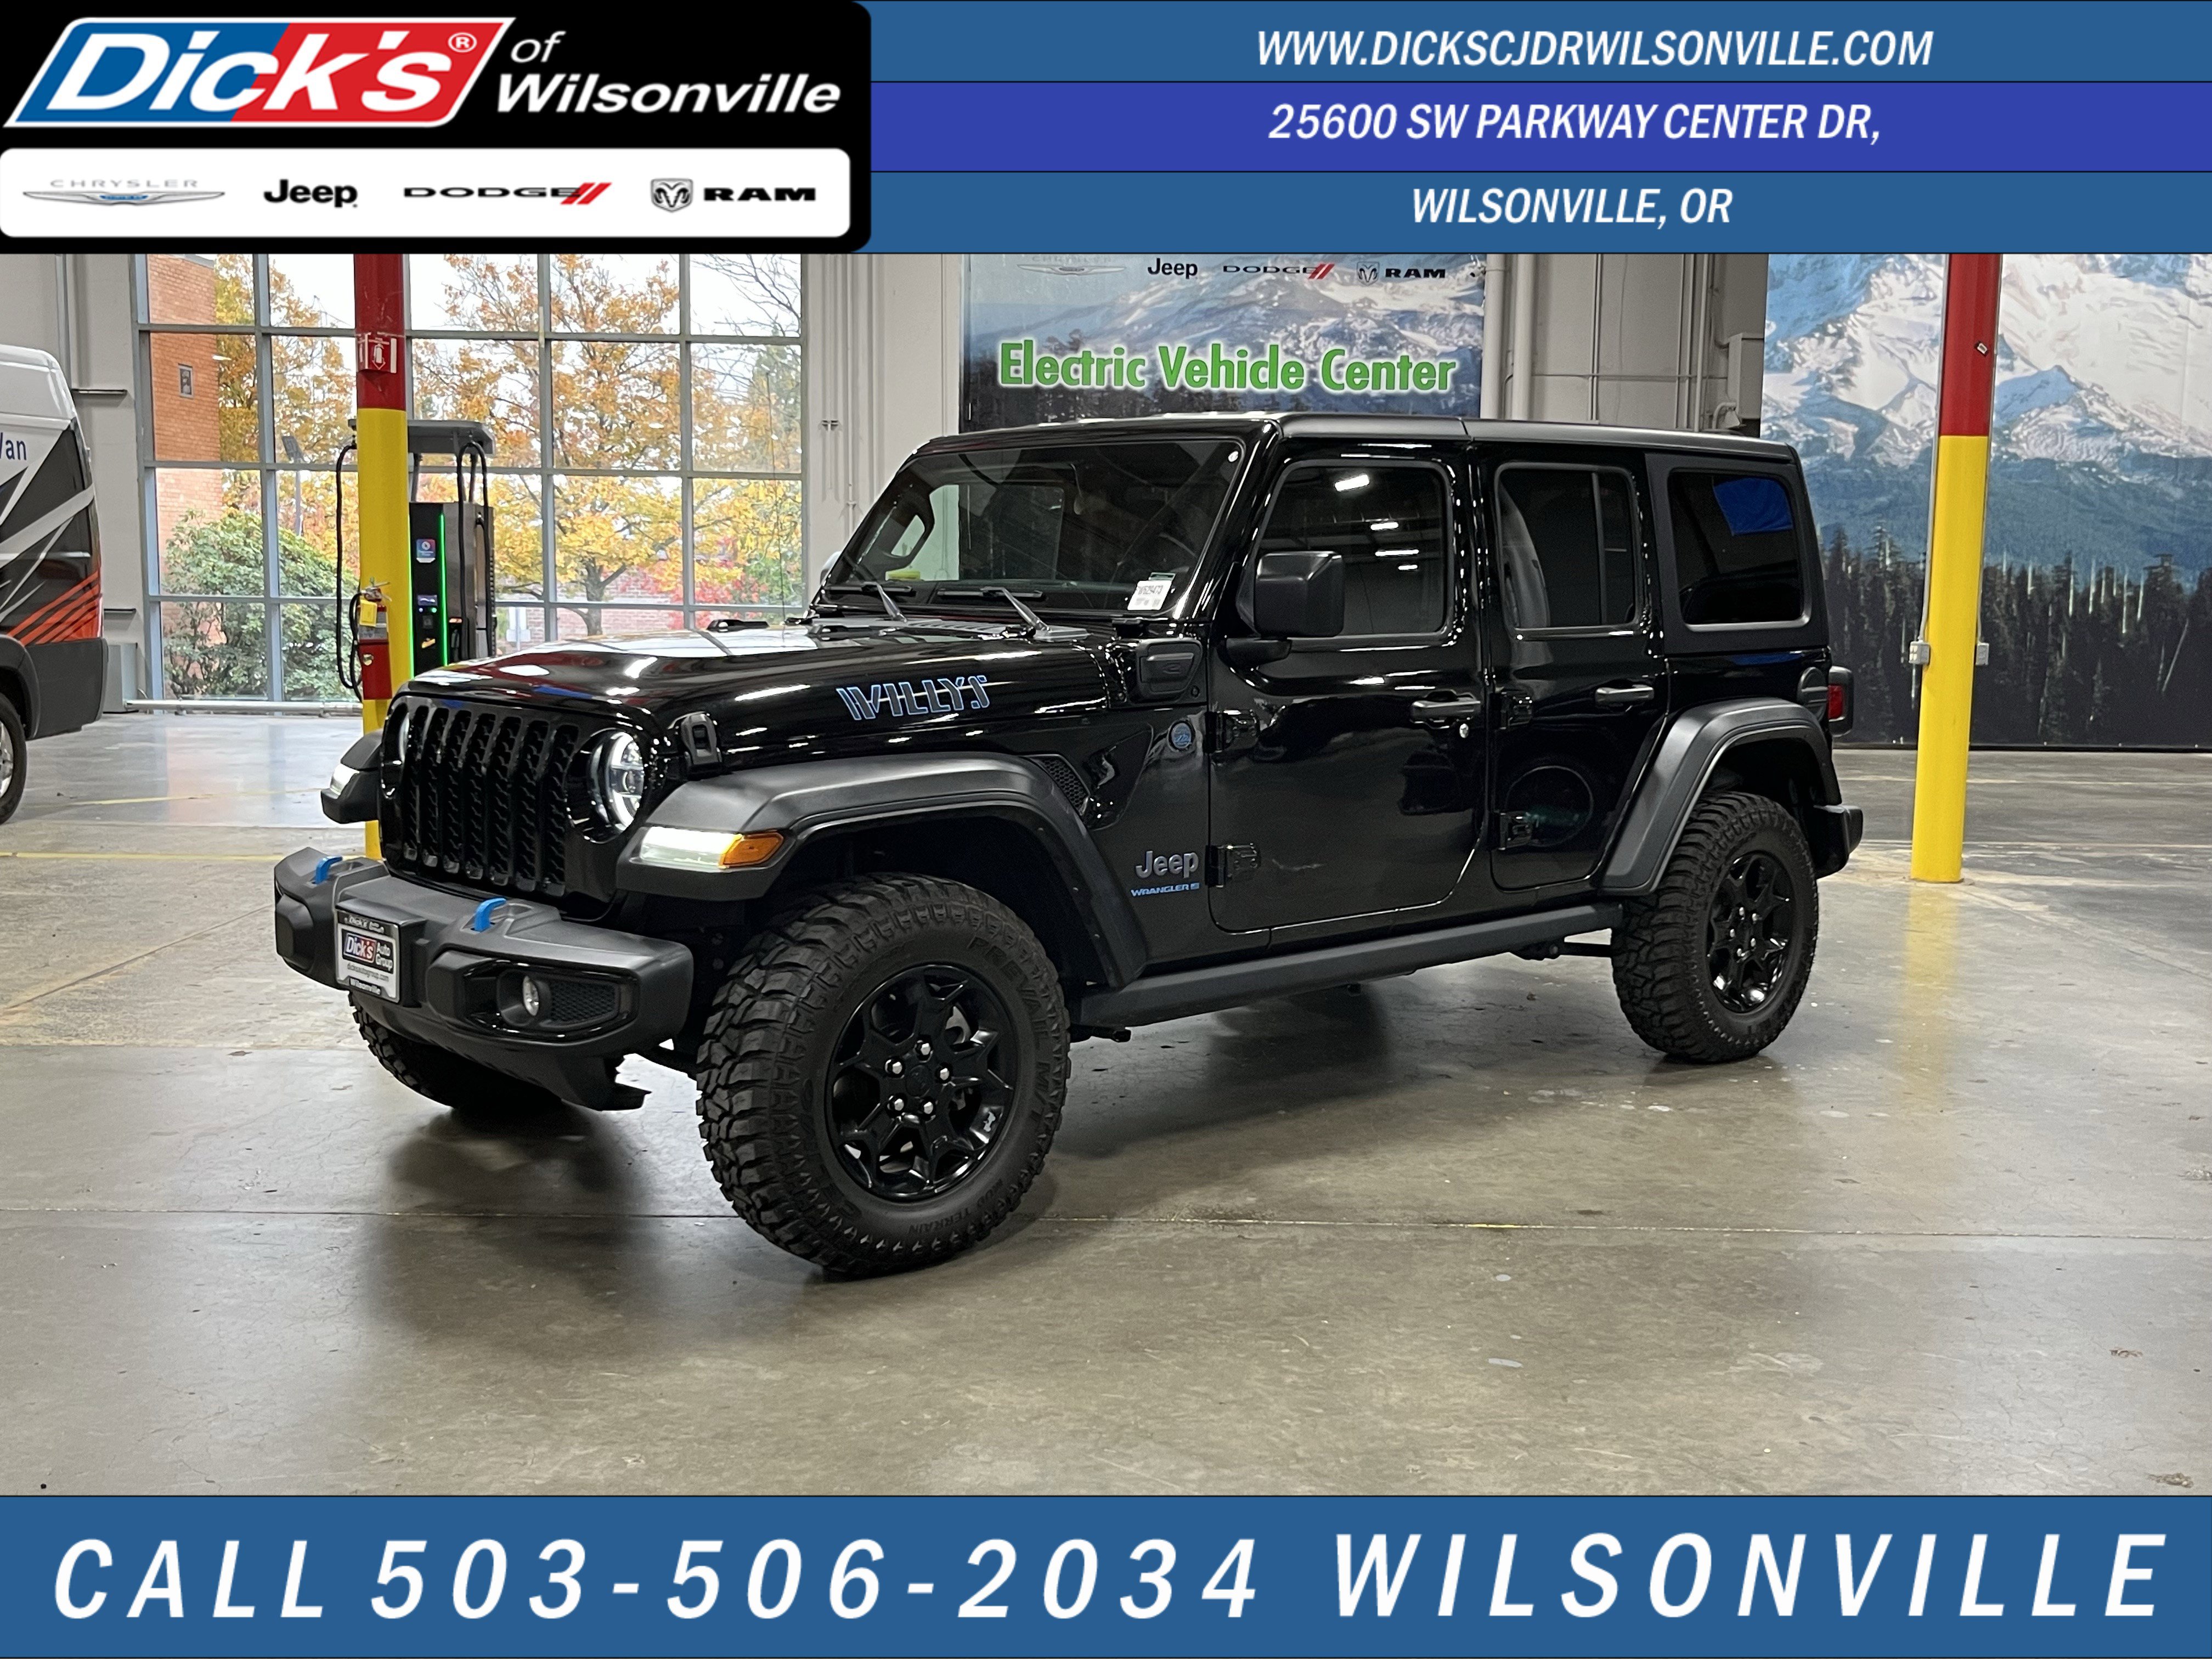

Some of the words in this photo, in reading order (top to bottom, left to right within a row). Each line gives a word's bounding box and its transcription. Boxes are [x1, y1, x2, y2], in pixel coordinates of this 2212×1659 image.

[1148, 258, 1198, 279] Jeep
[1223, 266, 1317, 274] DODGE
[1385, 268, 1446, 279] RAM
[1001, 340, 1146, 386] Electric
[1159, 343, 1305, 390] Vehicle
[1322, 348, 1456, 391] Center
[836, 675, 990, 720] WILLYS
[1136, 850, 1199, 878] Jeep
[1131, 884, 1189, 896] WRANGLER
[346, 936, 373, 959] Dick's
